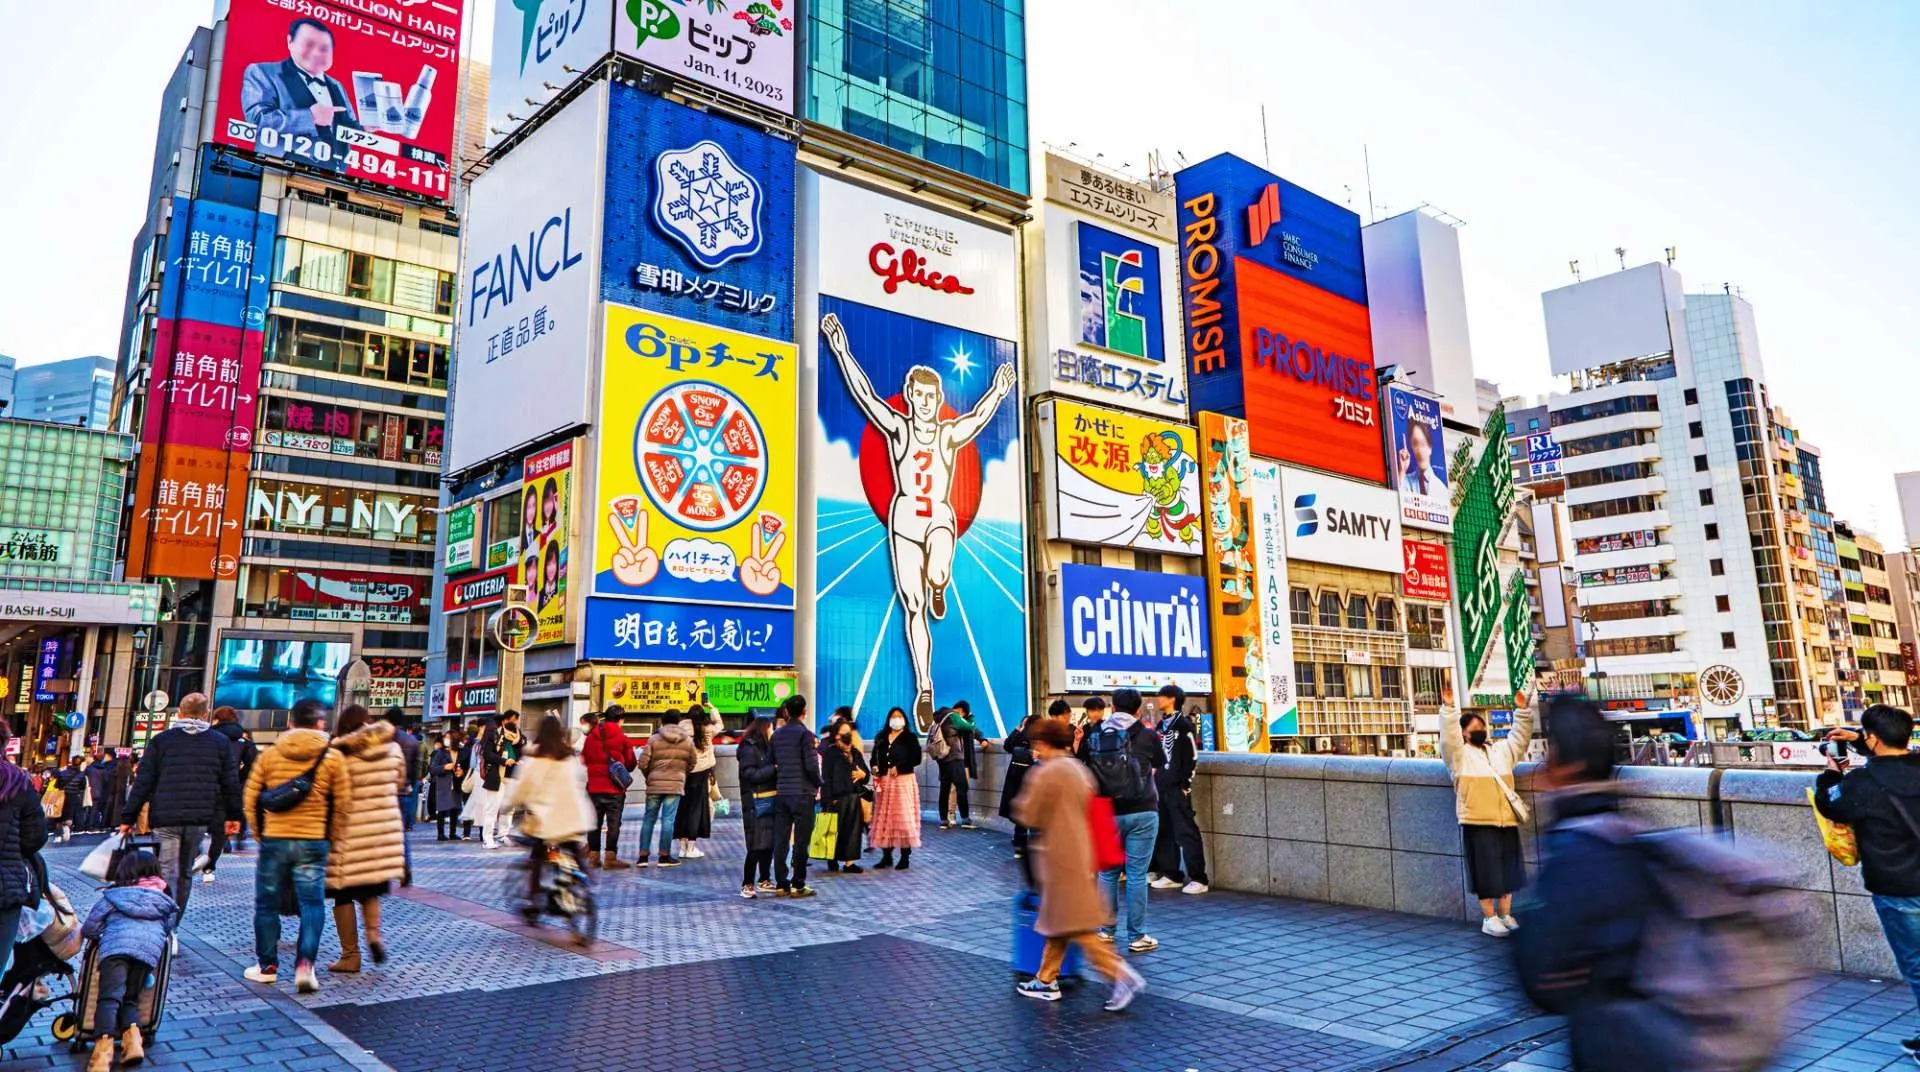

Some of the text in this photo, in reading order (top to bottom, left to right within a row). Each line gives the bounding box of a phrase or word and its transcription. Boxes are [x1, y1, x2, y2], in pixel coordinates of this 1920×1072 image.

[408, 14, 456, 40] HAIR
[688, 17, 756, 64] ピップ
[684, 54, 784, 102] Jan. 11, 2023
[339, 127, 379, 146] ルアン
[260, 127, 447, 192] 0120-494-111
[1080, 169, 1146, 205] 夢ある住まい
[1070, 188, 1158, 231] エステムシリーズ
[190, 229, 256, 265] 龍角散
[1282, 231, 1301, 246] SMBC
[1283, 241, 1319, 264] CONSUMER
[469, 207, 583, 328] FANCL
[869, 241, 975, 295] Glico
[1284, 250, 1313, 270] FINANCE
[635, 261, 777, 314] 雪印メグミルク
[1183, 192, 1226, 376] PROMISE
[485, 304, 558, 365] 正直品質。
[174, 351, 243, 384] 龍角散
[1255, 326, 1373, 400] PROMISE
[690, 394, 720, 407] SNOW
[1333, 395, 1375, 427] プロミス
[1408, 404, 1439, 430] Asking!
[286, 404, 350, 436] 焼肉
[650, 405, 672, 436] SNOW
[736, 419, 757, 451] SNOW
[1073, 413, 1125, 439] かぜに
[1069, 435, 1131, 474] 改源
[158, 478, 230, 510] 龍角散
[648, 460, 670, 494] SNOW
[735, 473, 755, 506] SNOW
[912, 448, 933, 518] グリコ
[251, 488, 322, 525] NY
[351, 498, 417, 534] NY
[684, 505, 717, 517] SNOW
[1326, 506, 1391, 542] SAMTY
[11, 530, 48, 544] なんば
[1263, 512, 1276, 569] 株式会社
[464, 576, 505, 600] LOTTERIA
[5, 604, 76, 619] BASHI-SUJI
[1071, 581, 1203, 659] CHINTAI
[1268, 575, 1281, 645] Asue
[613, 612, 773, 653] 明日を、元気に!
